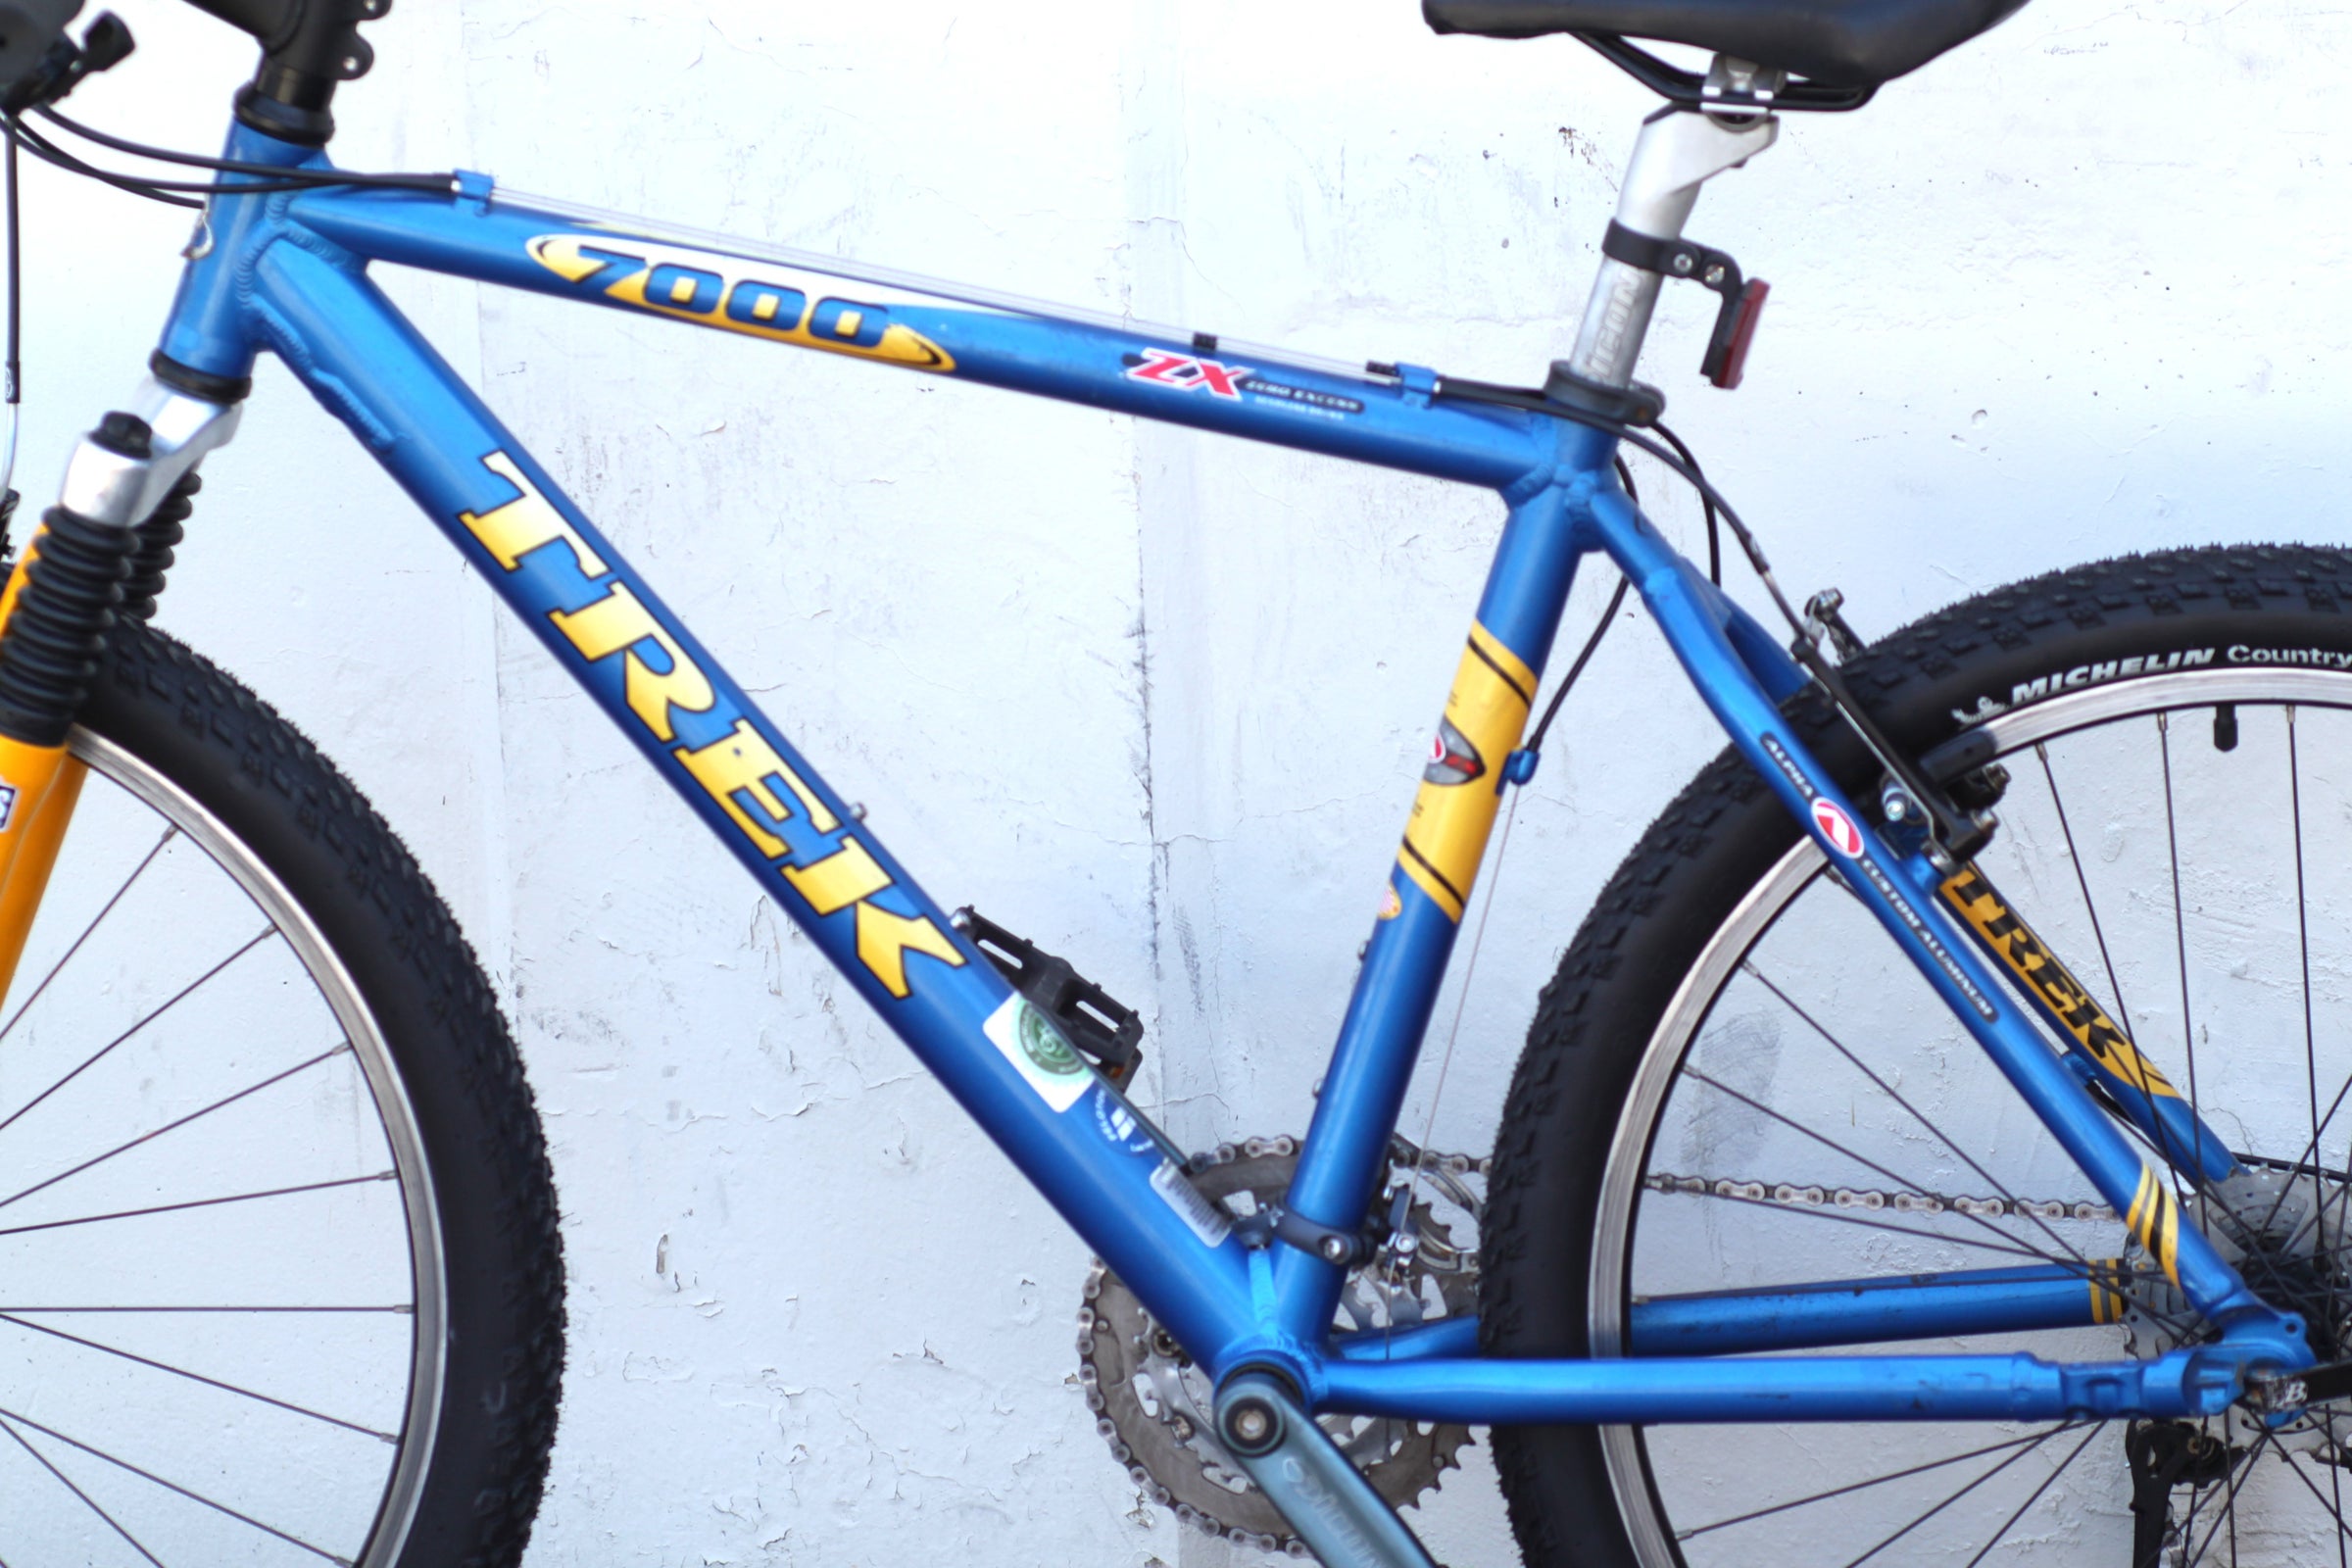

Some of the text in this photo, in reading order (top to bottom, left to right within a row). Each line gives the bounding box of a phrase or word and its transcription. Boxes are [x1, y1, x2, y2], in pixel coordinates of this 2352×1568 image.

[572, 244, 889, 348] 7000
[1125, 347, 1254, 402] ZX
[2012, 644, 2352, 705] MICHELIN Country
[459, 450, 969, 1000] TREK
[1765, 738, 1813, 798] ALPHA
[1952, 866, 2127, 1058] TREK
